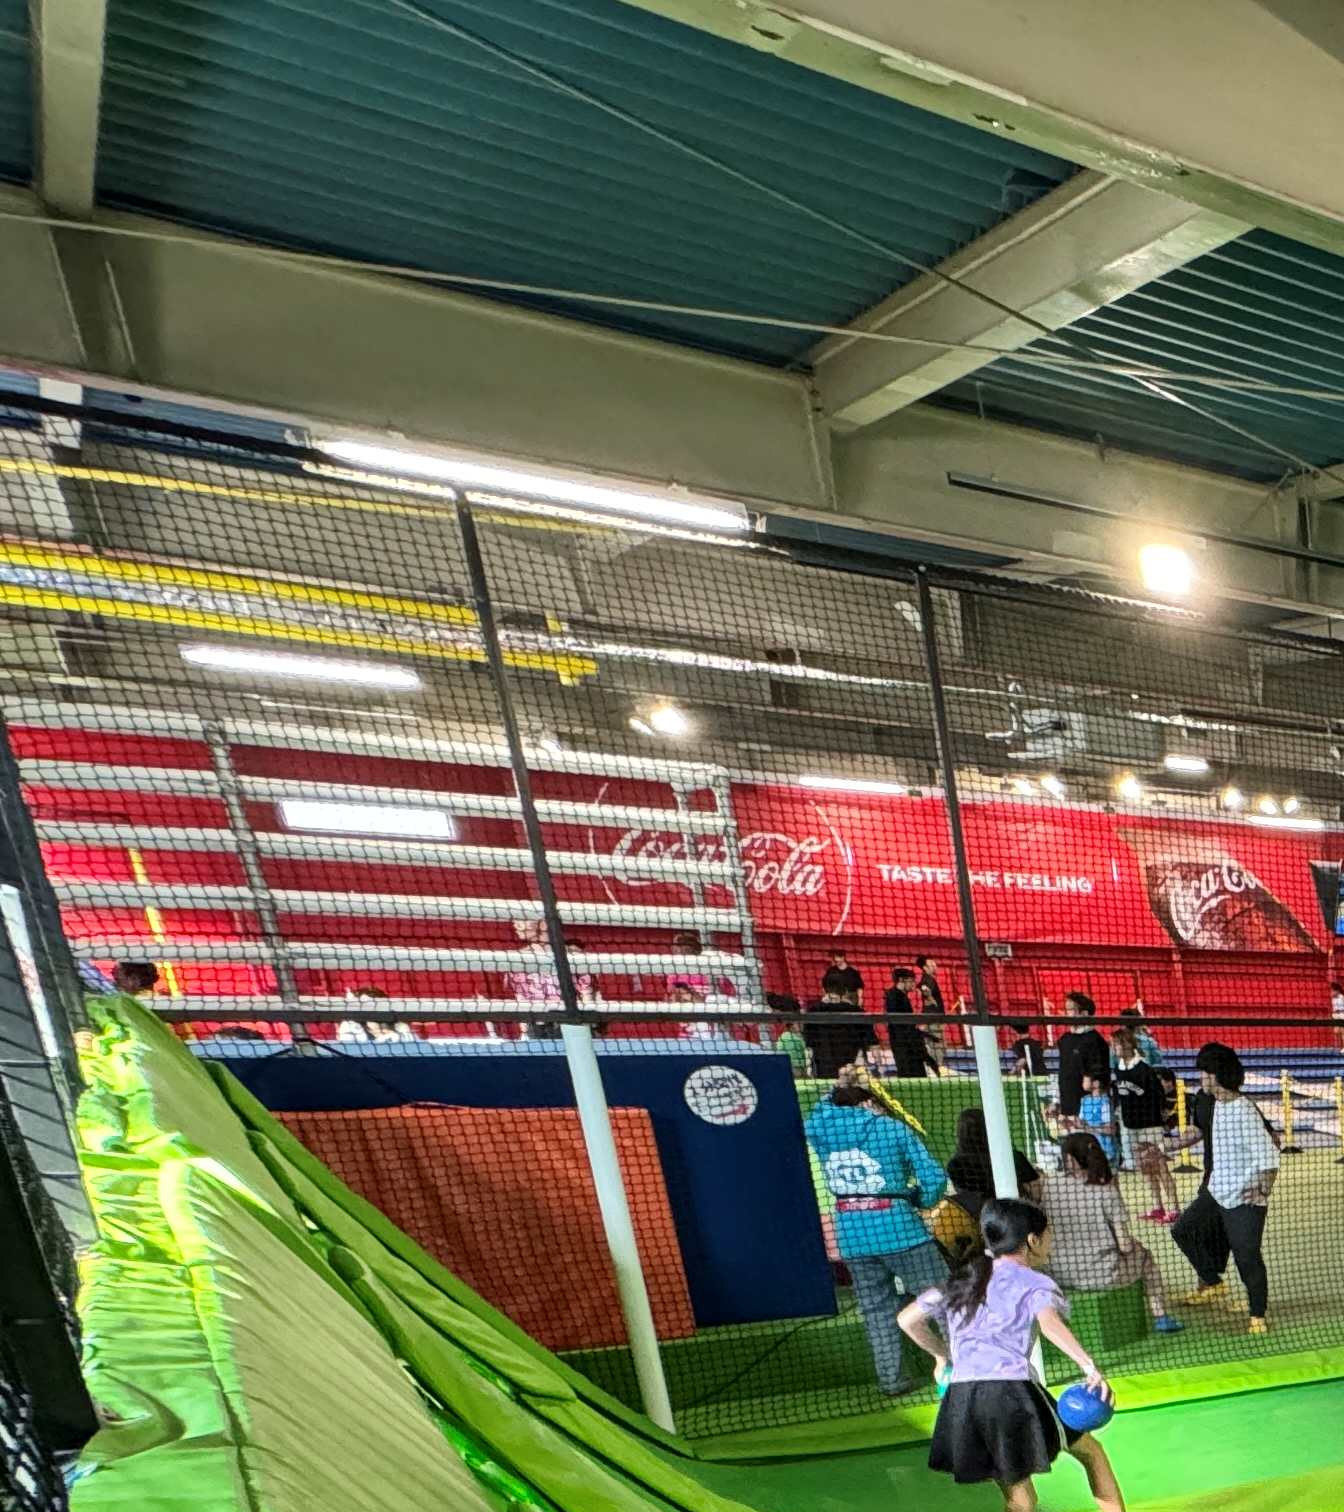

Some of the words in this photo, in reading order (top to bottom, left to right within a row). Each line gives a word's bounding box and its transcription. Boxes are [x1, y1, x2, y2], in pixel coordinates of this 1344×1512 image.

[877, 864, 951, 884] TASTE
[957, 869, 1001, 888] HE
[1003, 872, 1092, 895] FEELING
